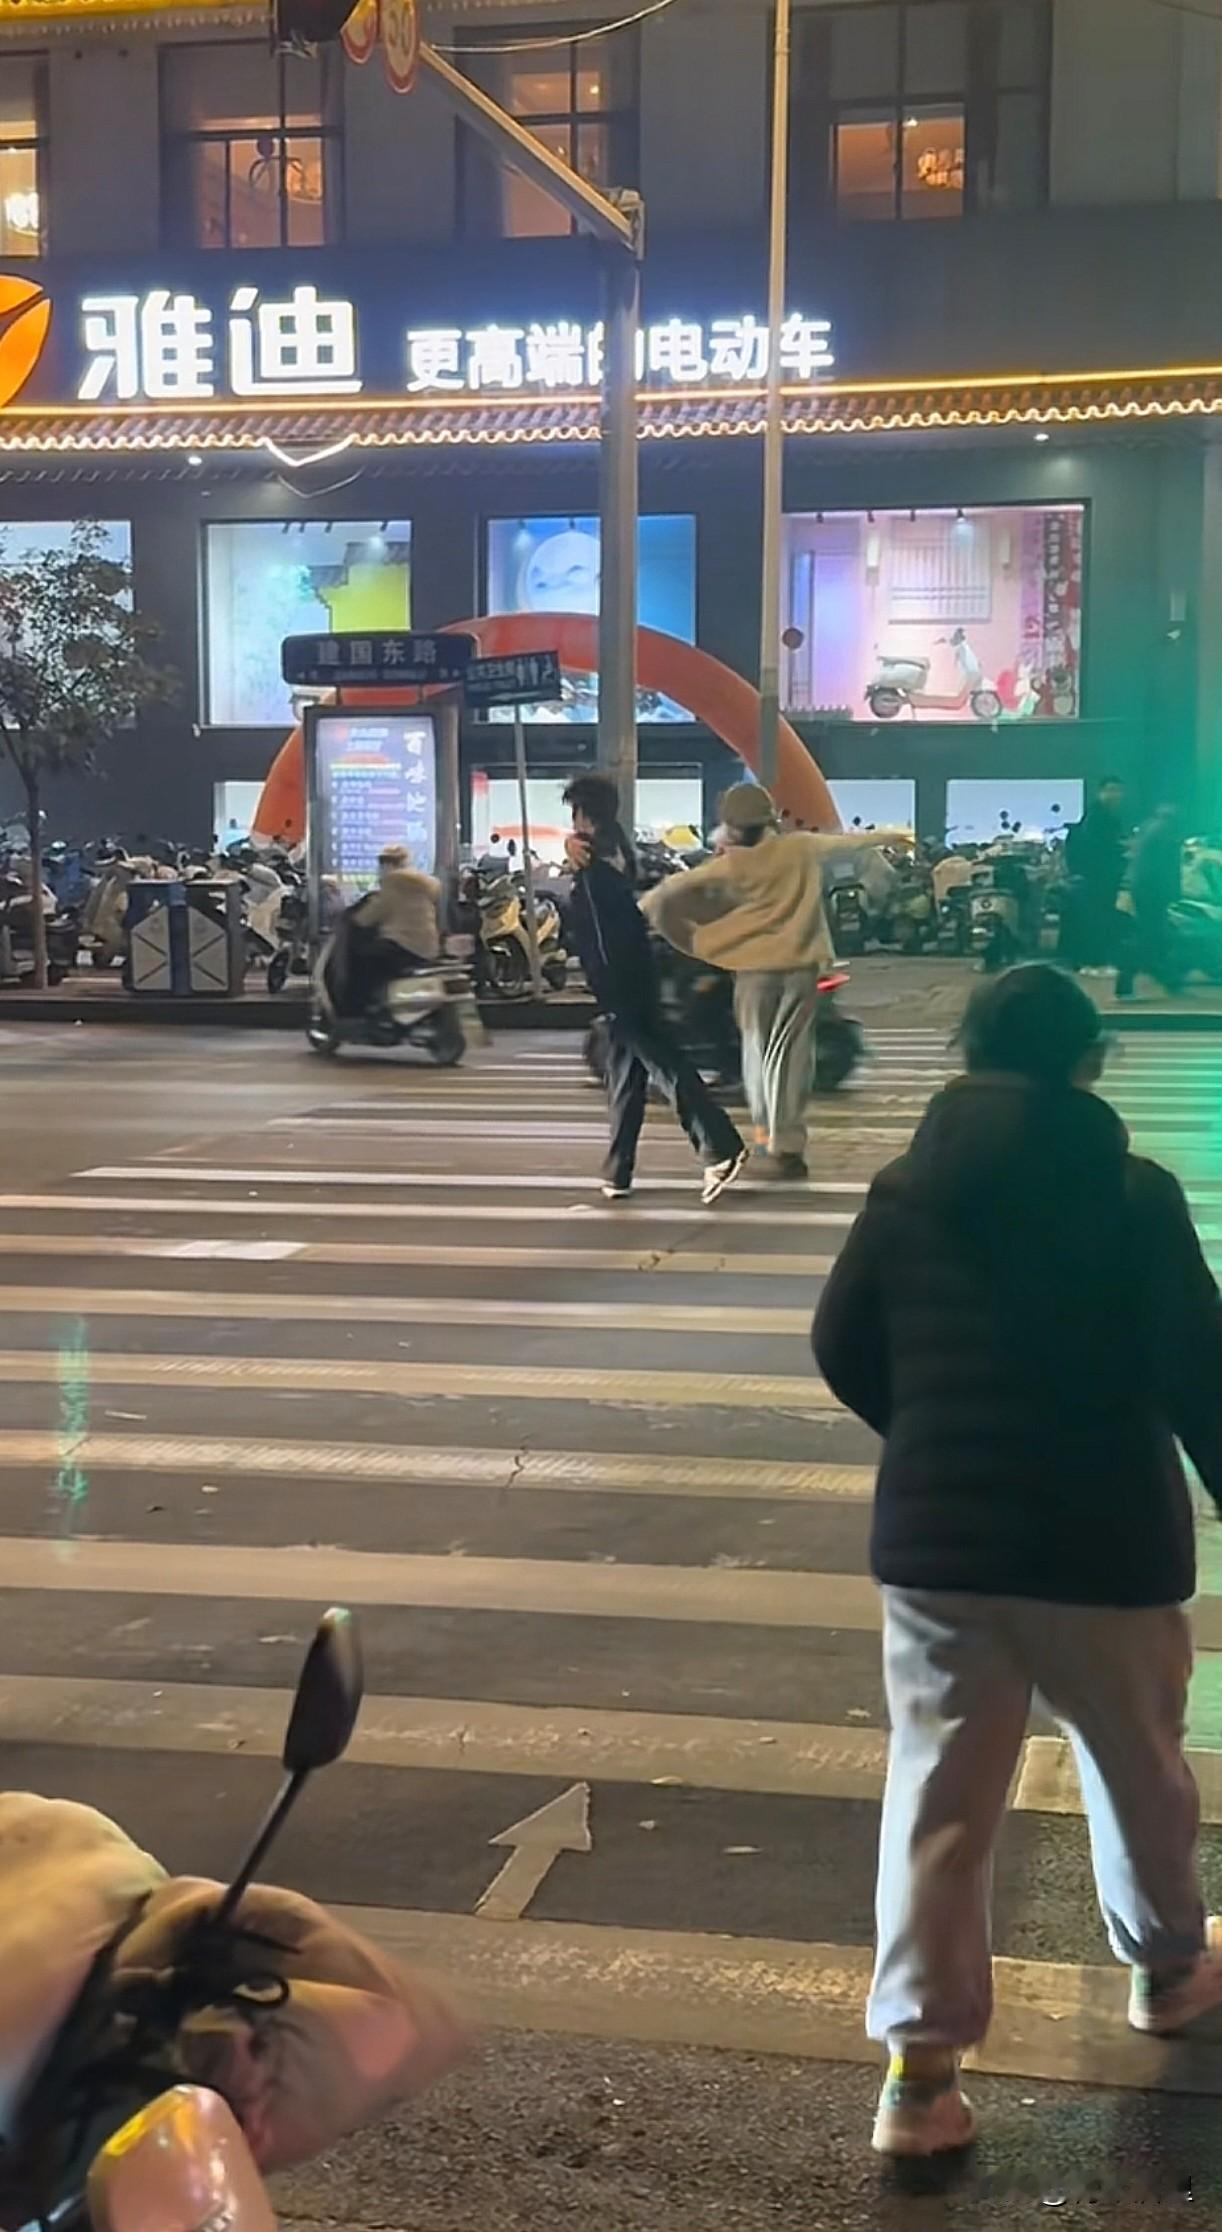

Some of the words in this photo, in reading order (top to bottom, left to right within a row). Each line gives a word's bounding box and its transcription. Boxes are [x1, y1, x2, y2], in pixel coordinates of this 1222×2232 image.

[78, 286, 363, 400] 雅迪
[317, 639, 437, 664] 建国东路
